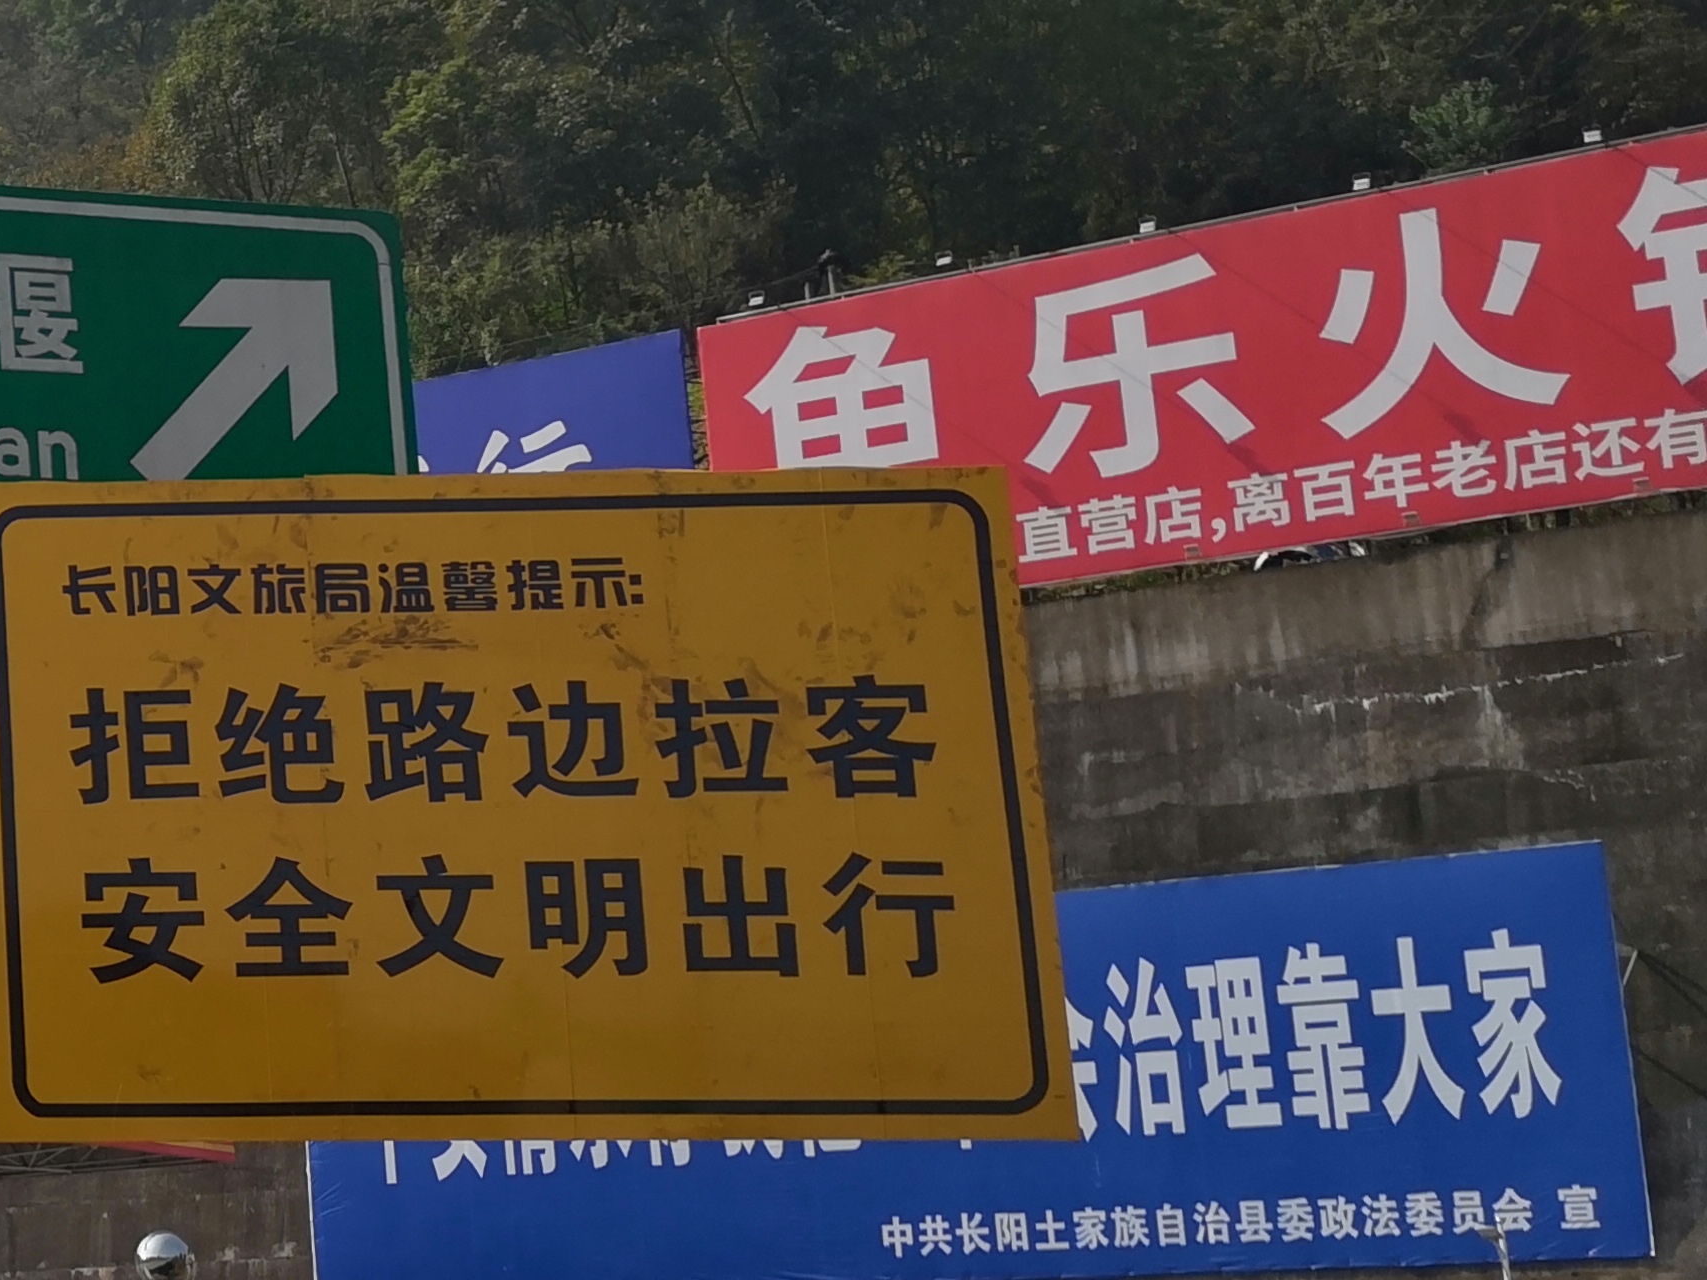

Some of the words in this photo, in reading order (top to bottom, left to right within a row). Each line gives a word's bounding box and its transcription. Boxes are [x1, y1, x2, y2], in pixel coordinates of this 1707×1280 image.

[62, 556, 644, 618] 长阳文旅局温馨提示:
[69, 675, 938, 806] 拒绝路边拉客
[81, 853, 955, 984] 安全文明出行
[1556, 1183, 1601, 1232] 宣
